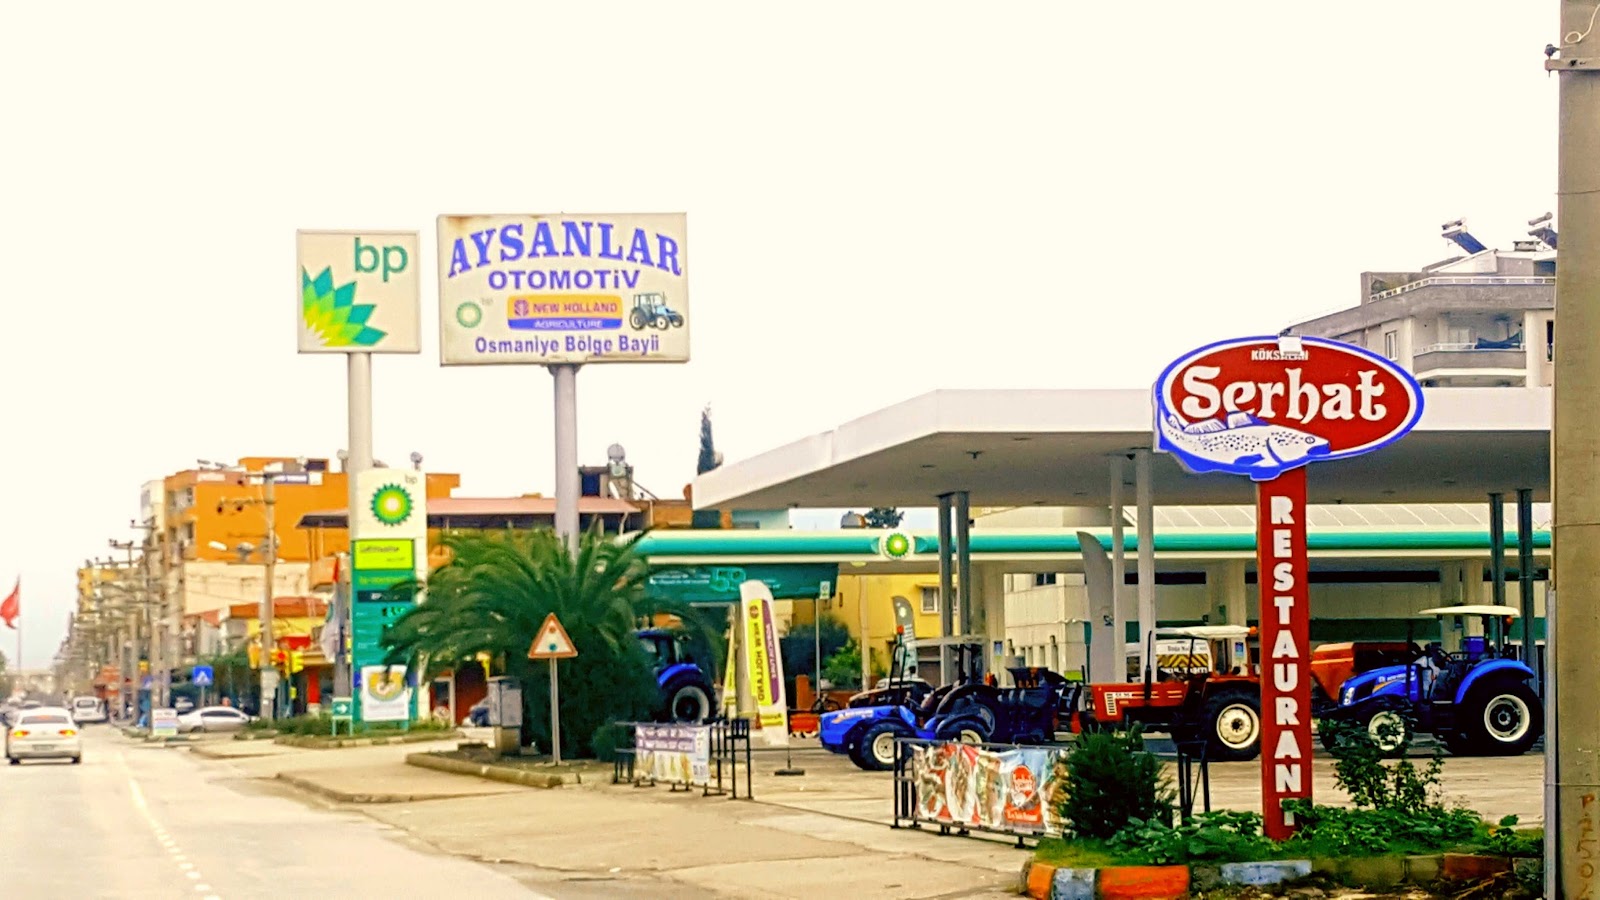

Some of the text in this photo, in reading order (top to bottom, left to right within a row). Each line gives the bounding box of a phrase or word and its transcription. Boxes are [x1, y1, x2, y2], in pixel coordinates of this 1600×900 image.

[354, 236, 409, 282] bp
[448, 221, 682, 277] AYSANLAR
[533, 302, 618, 313] NEW HOLLAND
[534, 320, 603, 329] AGRICULTURE
[475, 334, 660, 357] Osmaniye Bölge Bayii
[1181, 365, 1388, 425] Serhat
